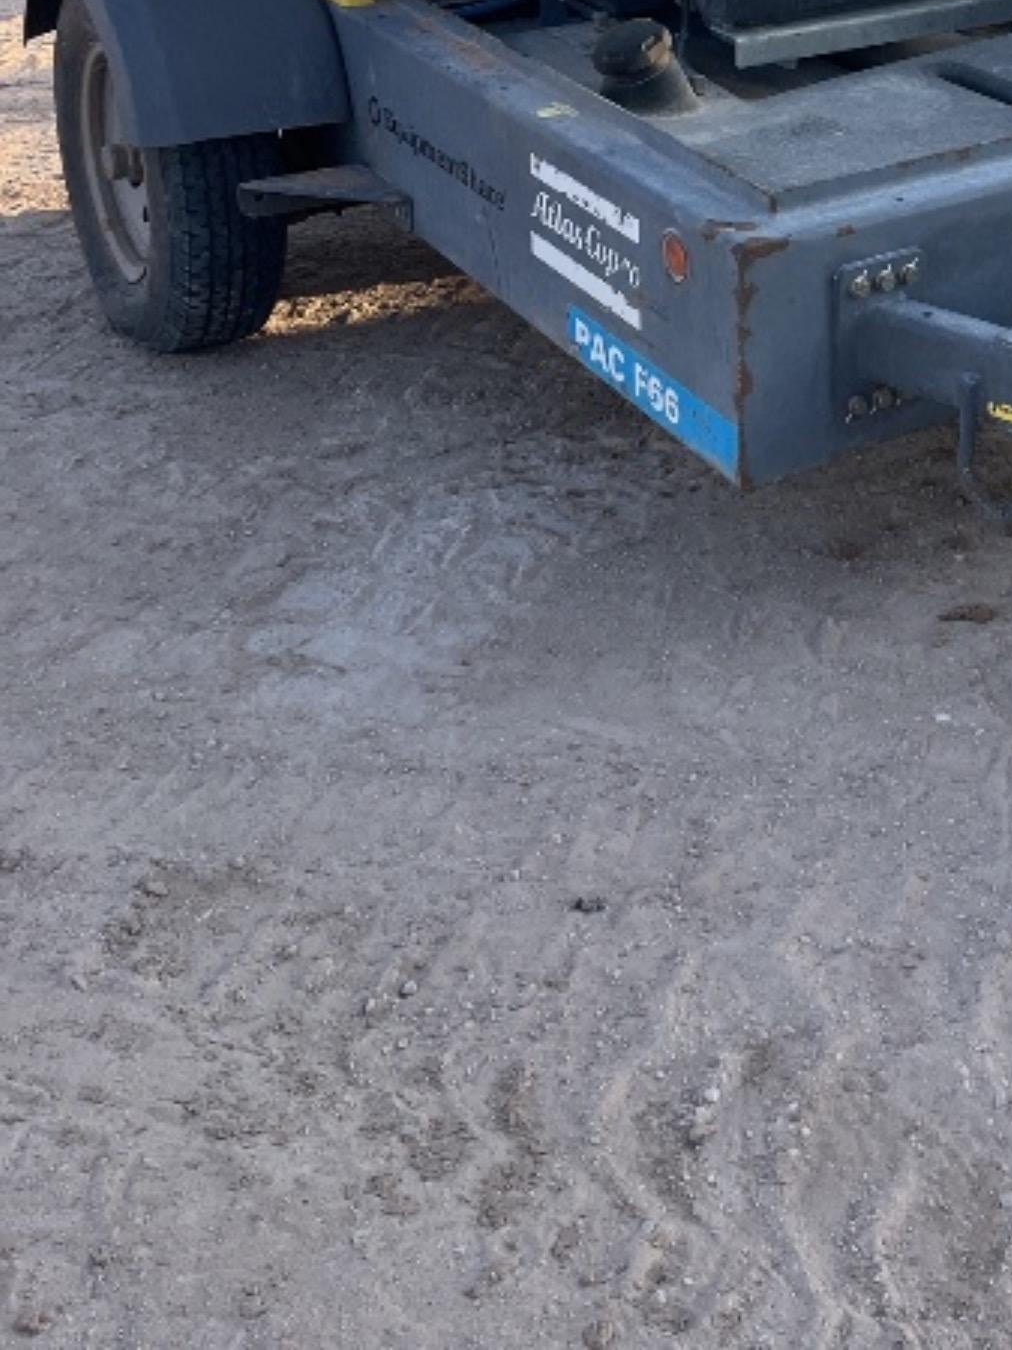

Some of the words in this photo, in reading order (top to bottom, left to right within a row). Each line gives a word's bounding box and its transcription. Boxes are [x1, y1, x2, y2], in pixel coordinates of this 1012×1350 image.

[530, 191, 583, 250] Atlas
[574, 316, 626, 383] PAC
[633, 361, 680, 425] F66
